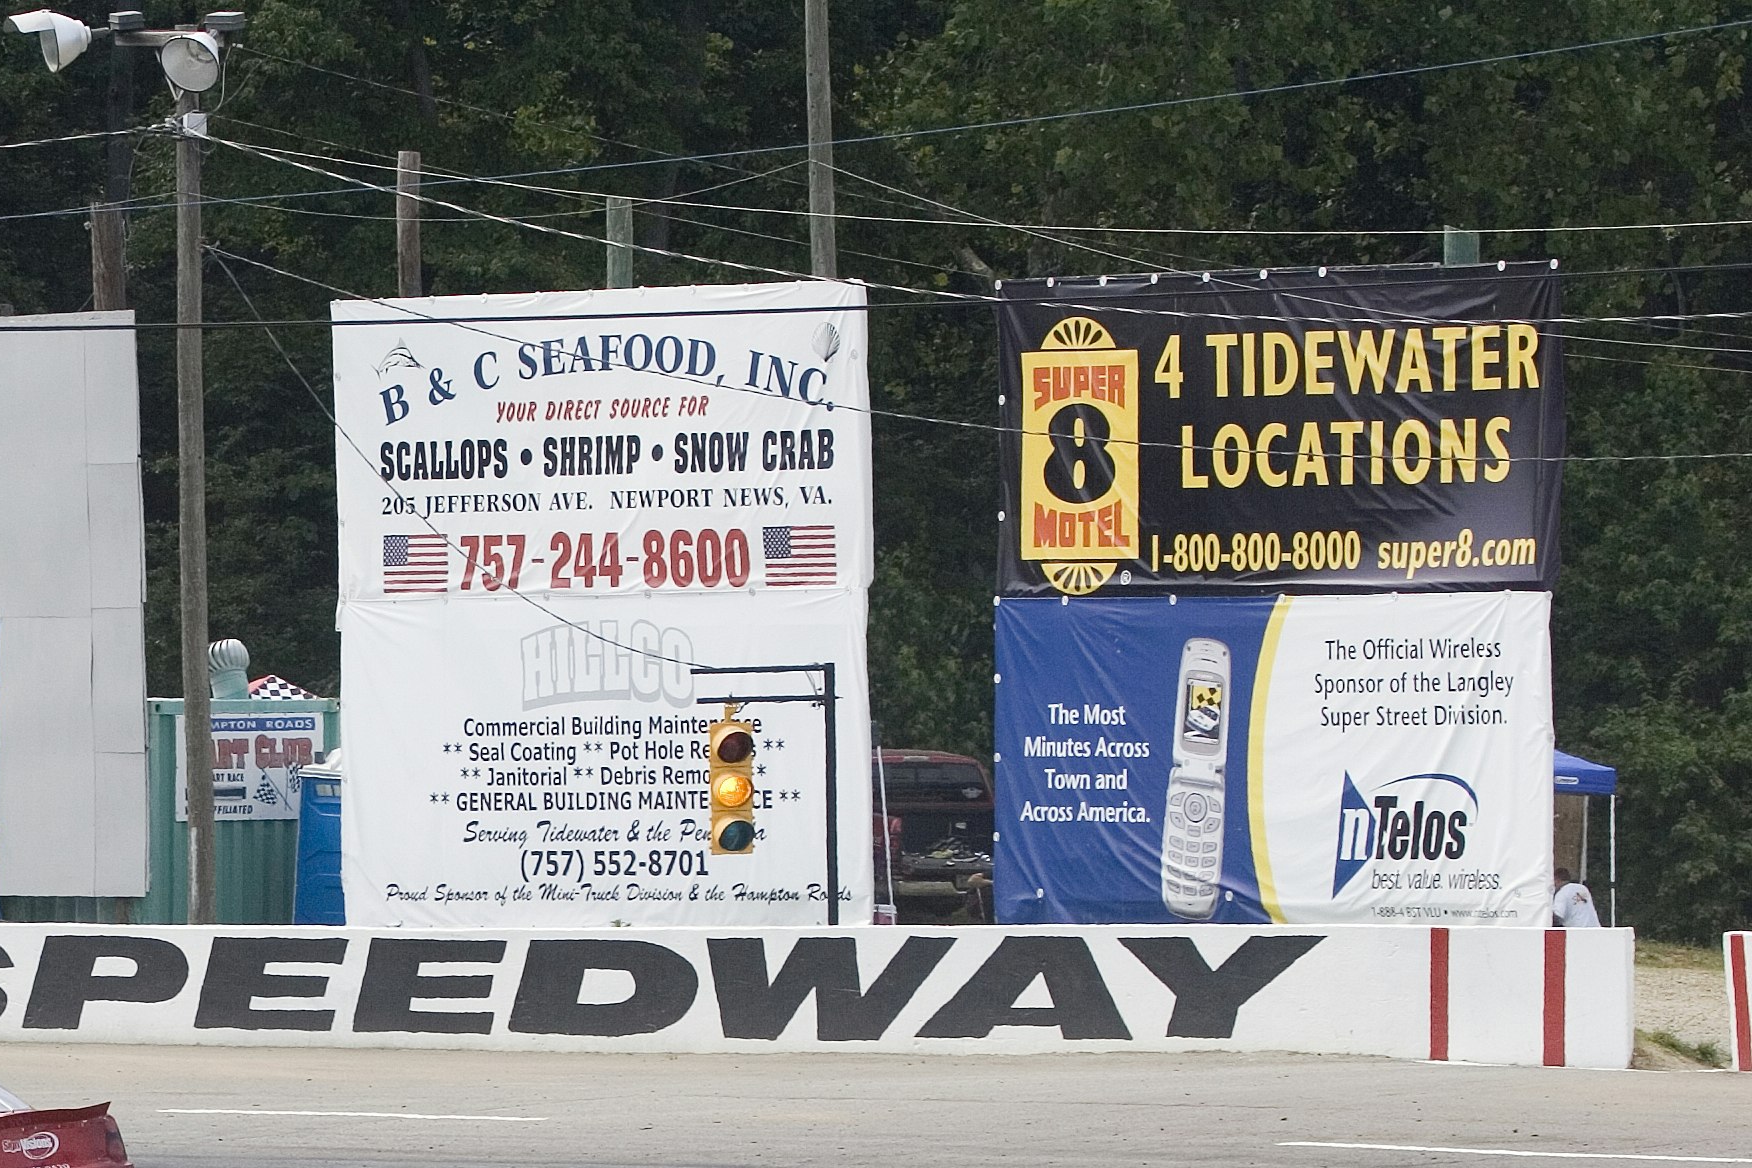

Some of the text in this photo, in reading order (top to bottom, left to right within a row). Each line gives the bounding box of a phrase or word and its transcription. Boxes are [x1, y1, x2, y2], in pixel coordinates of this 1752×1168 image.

[1154, 324, 1540, 399] 4 TIDEWATER
[378, 383, 410, 426] B
[428, 367, 457, 406] &
[474, 350, 501, 391] C
[744, 349, 836, 413] INC.
[1032, 365, 1126, 410] SUPER
[496, 395, 710, 423] YOUR DIRECT SOURCE FOR
[380, 428, 834, 482] SCALLOPS SHRIMP SNOW CRAB
[1044, 403, 1116, 503] 8
[1182, 416, 1511, 489] LOCATIONS
[381, 486, 832, 520] 205 JEFFERSON AVE. NEWPORT NEWS, VA.
[1033, 500, 1130, 548] MOTEL
[460, 528, 750, 591] 757-244-8600
[1152, 529, 1536, 578] 1-800-800-8000 super8.com
[1324, 638, 1501, 661] The Official Wireless
[520, 619, 694, 712] HILLCO
[1314, 671, 1514, 700] Sponsor of the Langley
[266, 720, 313, 728] ROADS
[463, 715, 762, 739] Commercial Building Maintee
[1048, 704, 1126, 726] The Most
[1321, 703, 1507, 731] Super Street Division.
[255, 734, 313, 768] CLUB
[469, 743, 504, 761] Seal
[510, 742, 576, 765] Coating
[610, 741, 638, 760] Pot
[645, 741, 688, 760] Hole
[1024, 736, 1150, 760] Minutes Across
[487, 766, 656, 786] Janitorial Debris
[1045, 768, 1127, 791] Town and
[456, 791, 773, 812] GENERAL BUILDING MAINTECE
[1020, 801, 1151, 824] Across America.
[463, 821, 528, 848] Serving
[536, 820, 619, 842] Tidewater
[626, 820, 640, 841] &
[646, 821, 672, 842] the
[1340, 796, 1467, 861] nTelos
[521, 850, 709, 882] (757) 552-8701
[1372, 869, 1502, 890] best. value. wireless.
[386, 884, 428, 900] Proud
[434, 884, 488, 905] Sponsor
[495, 885, 507, 905] of
[512, 885, 532, 900] the
[539, 883, 620, 900] Mini-Truck
[627, 883, 682, 901] Division
[705, 885, 724, 900] the
[732, 884, 799, 905] Hampton
[807, 884, 852, 900] Rods
